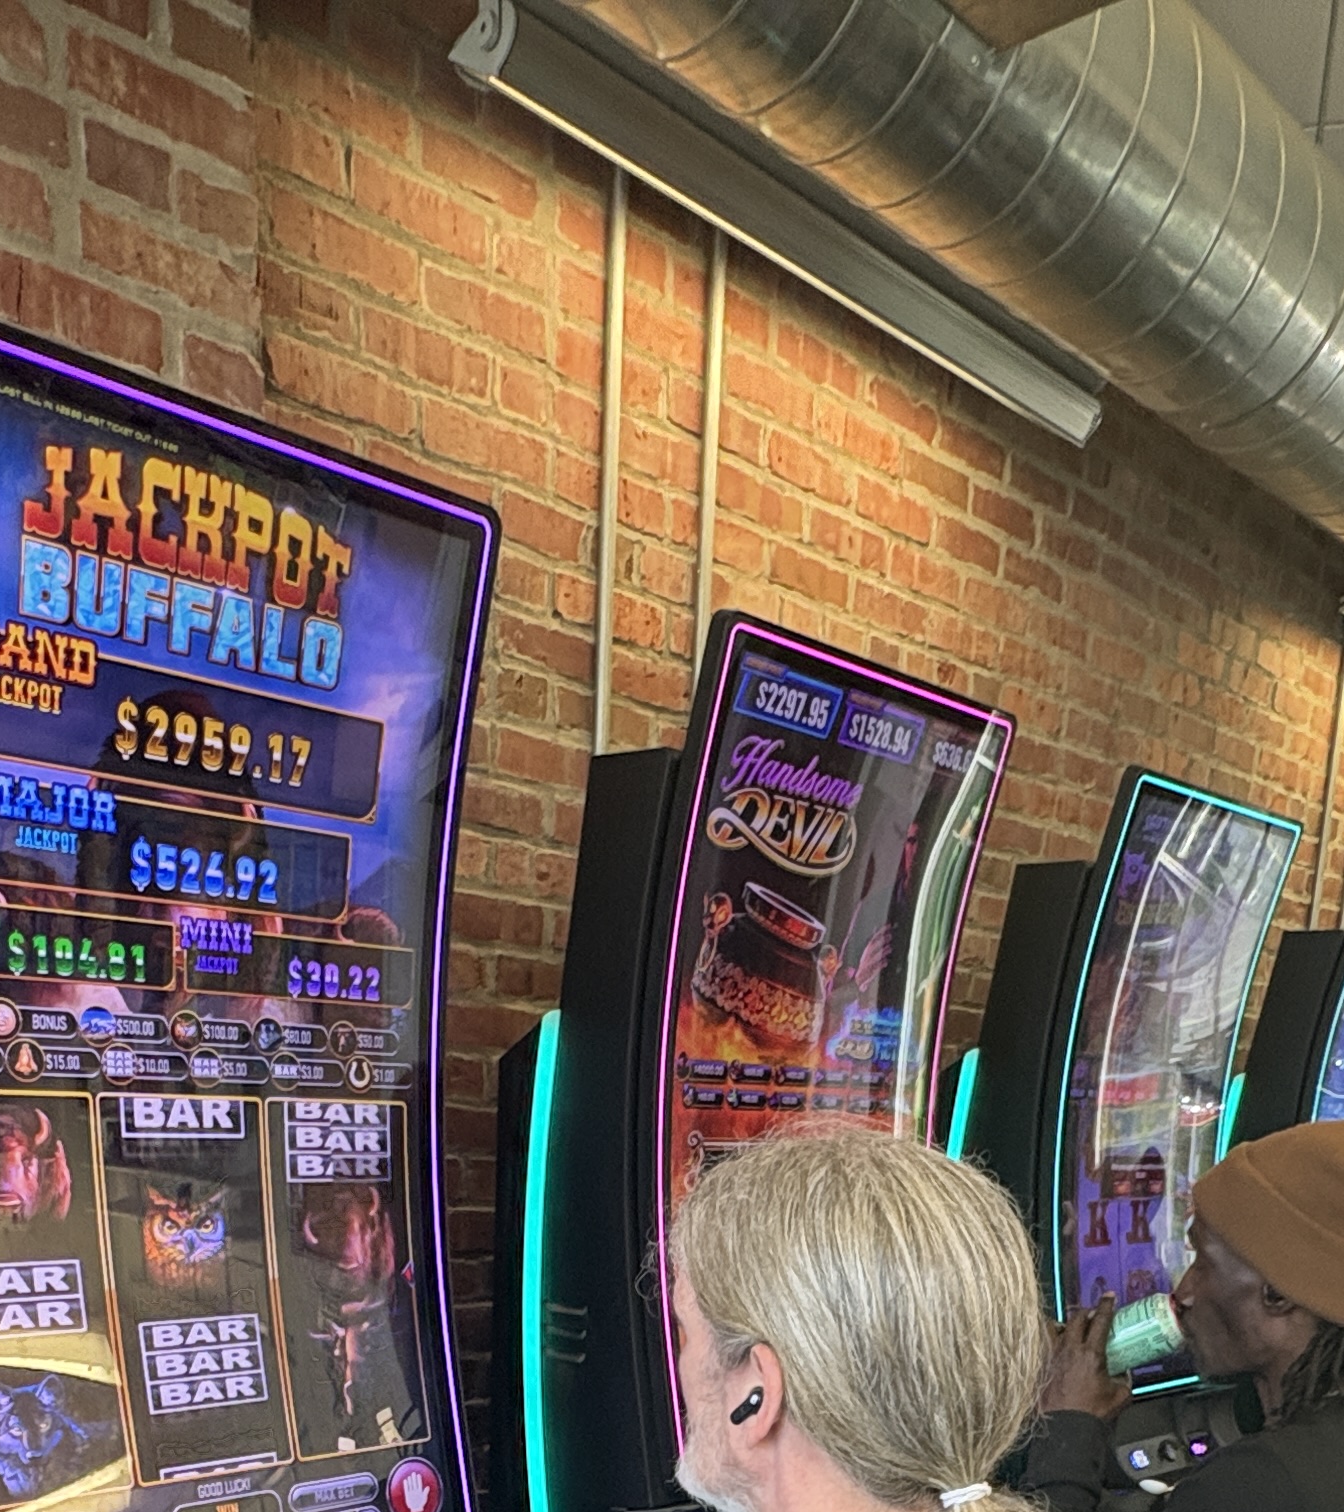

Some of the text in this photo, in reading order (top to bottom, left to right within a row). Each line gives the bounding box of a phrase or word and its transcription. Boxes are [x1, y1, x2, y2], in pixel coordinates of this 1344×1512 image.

[23, 445, 352, 618] JACKPOT
[19, 534, 344, 690] BUFFALO
[756, 681, 832, 729] $2297.95
[115, 697, 312, 787] $2959.17
[849, 713, 913, 756] $1528.94
[721, 735, 864, 809] Handsome
[15, 826, 79, 855] JACKPOT
[707, 788, 856, 876] DEVIL
[130, 837, 279, 904] $526.92
[180, 916, 253, 954] MINI
[8, 930, 146, 982] $104.81
[288, 956, 380, 1001] $30.22
[32, 1014, 68, 1032] BONUS
[116, 1020, 155, 1037] $500.00
[203, 1024, 239, 1041] $100.00
[46, 1054, 80, 1071] $15.00
[138, 1058, 170, 1074] $10.00
[223, 1061, 248, 1077] $5.00
[133, 1097, 233, 1128] BAR
[295, 1102, 380, 1124] BAR
[296, 1127, 381, 1152] BAR
[297, 1155, 381, 1177] BAR
[151, 1319, 249, 1348] BAR
[156, 1348, 253, 1377] BAR
[160, 1376, 257, 1407] BAR
[197, 1481, 224, 1499] GOOD
